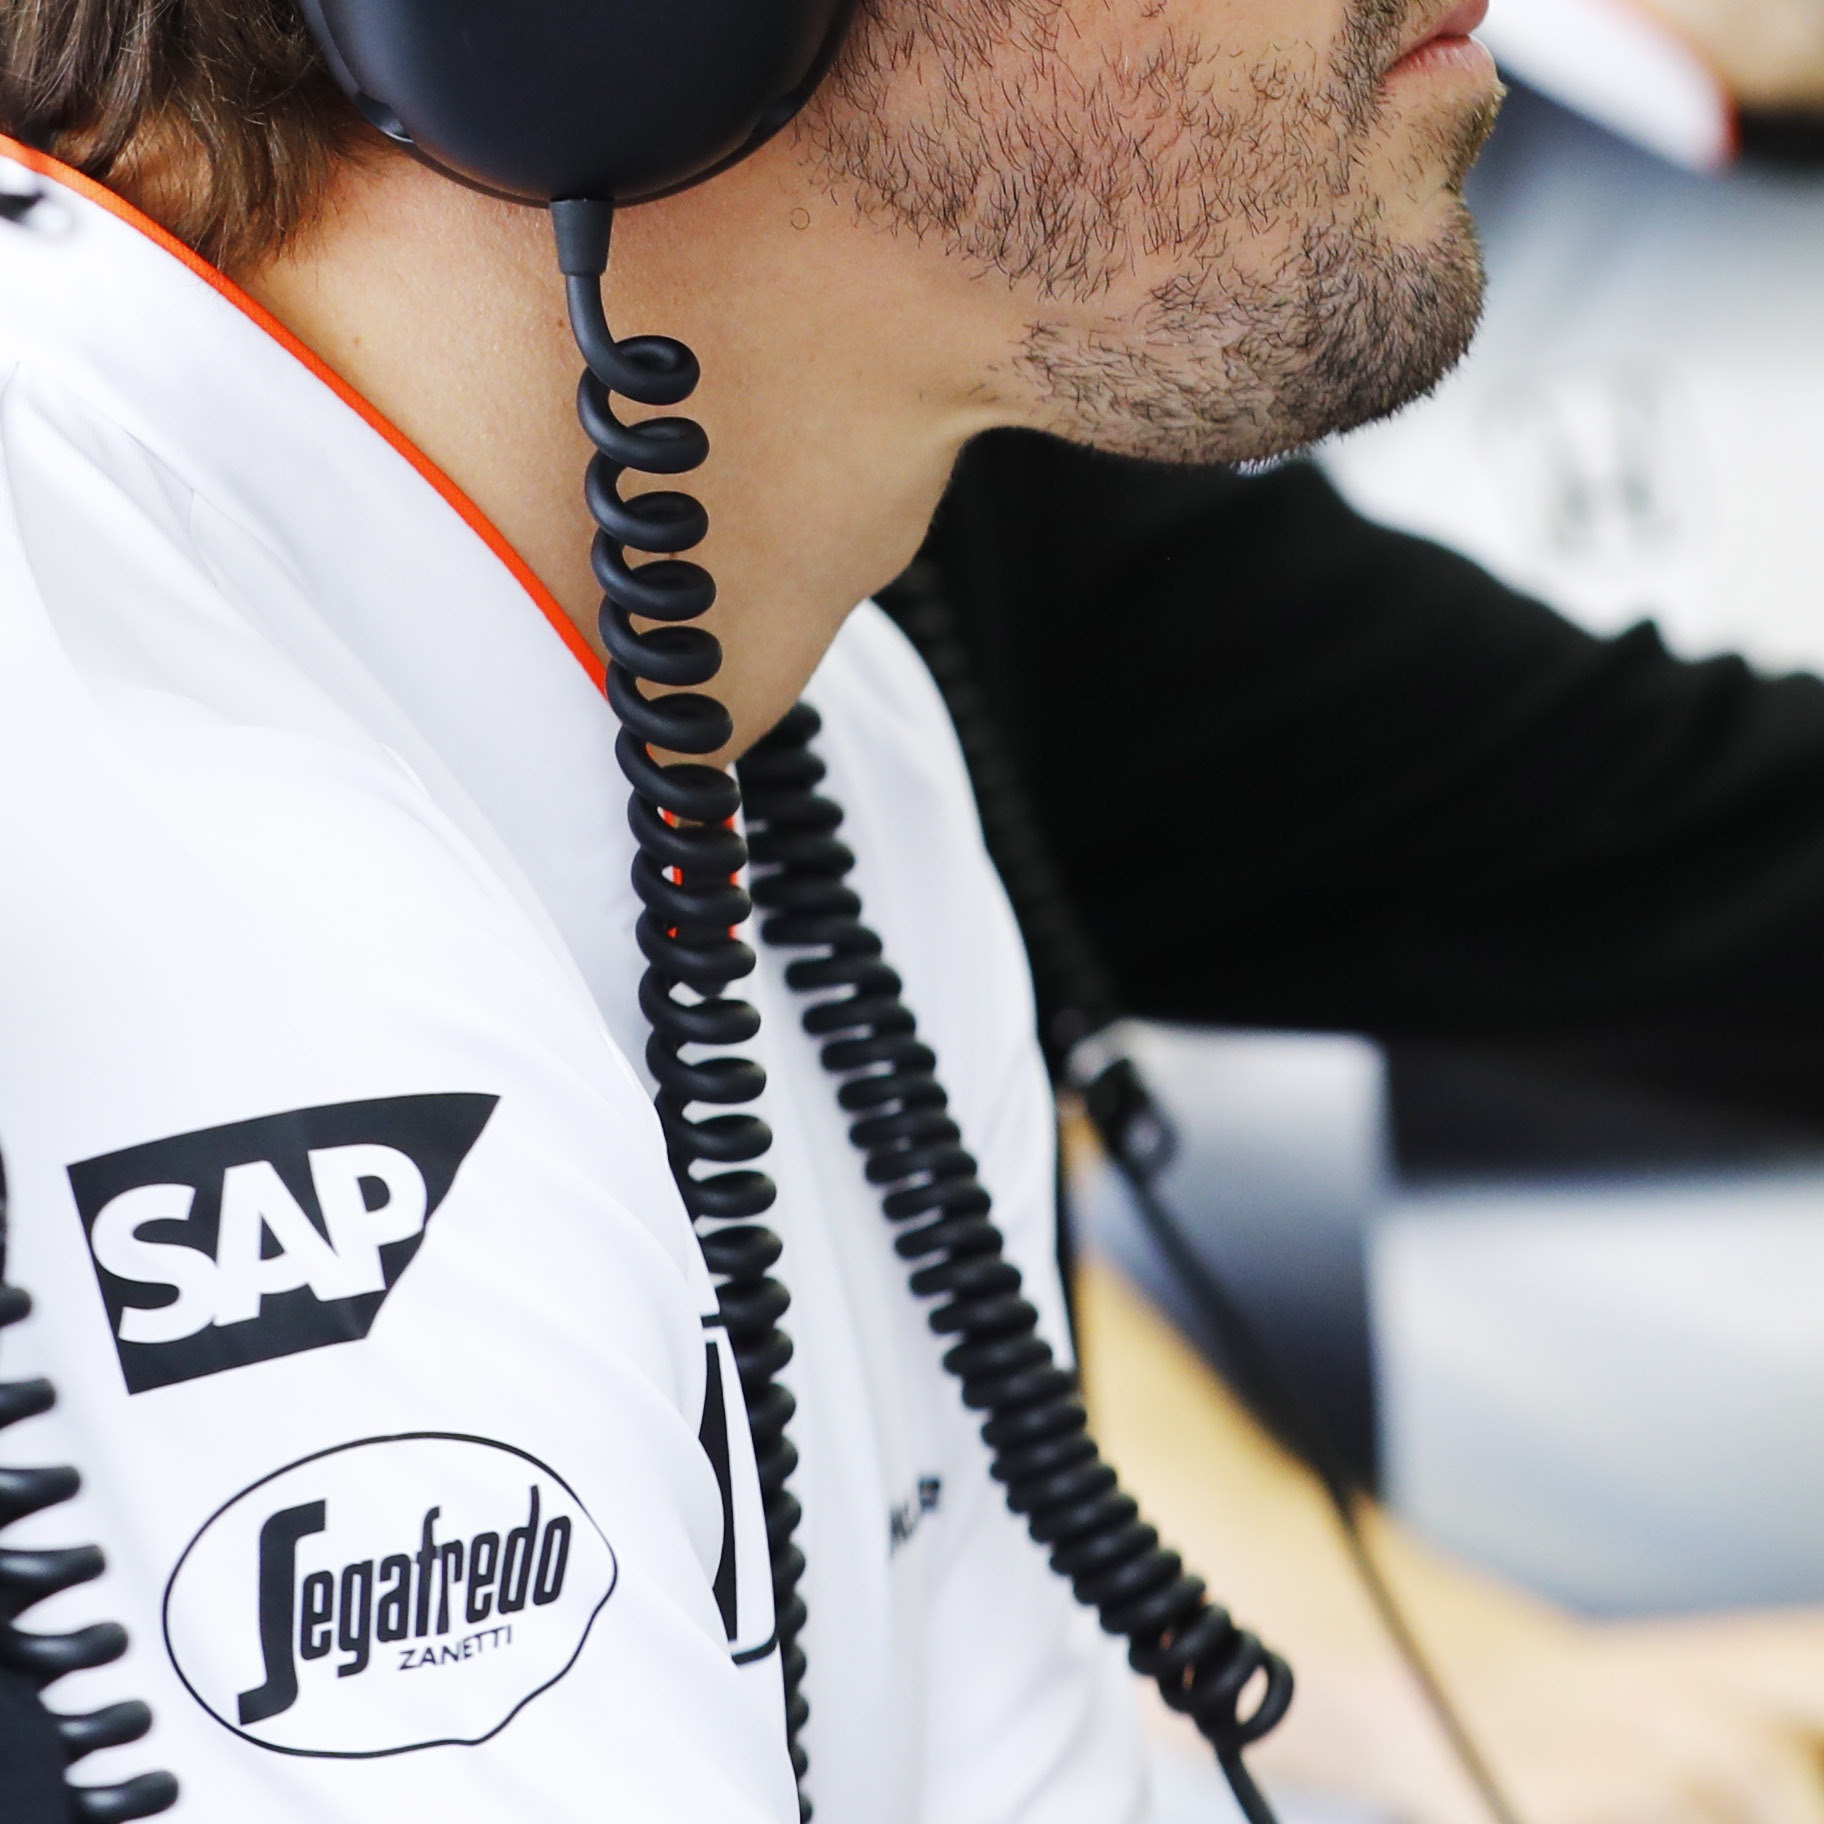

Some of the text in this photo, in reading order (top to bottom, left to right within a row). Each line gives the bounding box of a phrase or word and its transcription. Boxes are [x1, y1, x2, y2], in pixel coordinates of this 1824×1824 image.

[90, 1142, 429, 1344] SAP
[237, 1483, 573, 1726] Segafredo
[398, 1625, 513, 1671] ZANETTI
